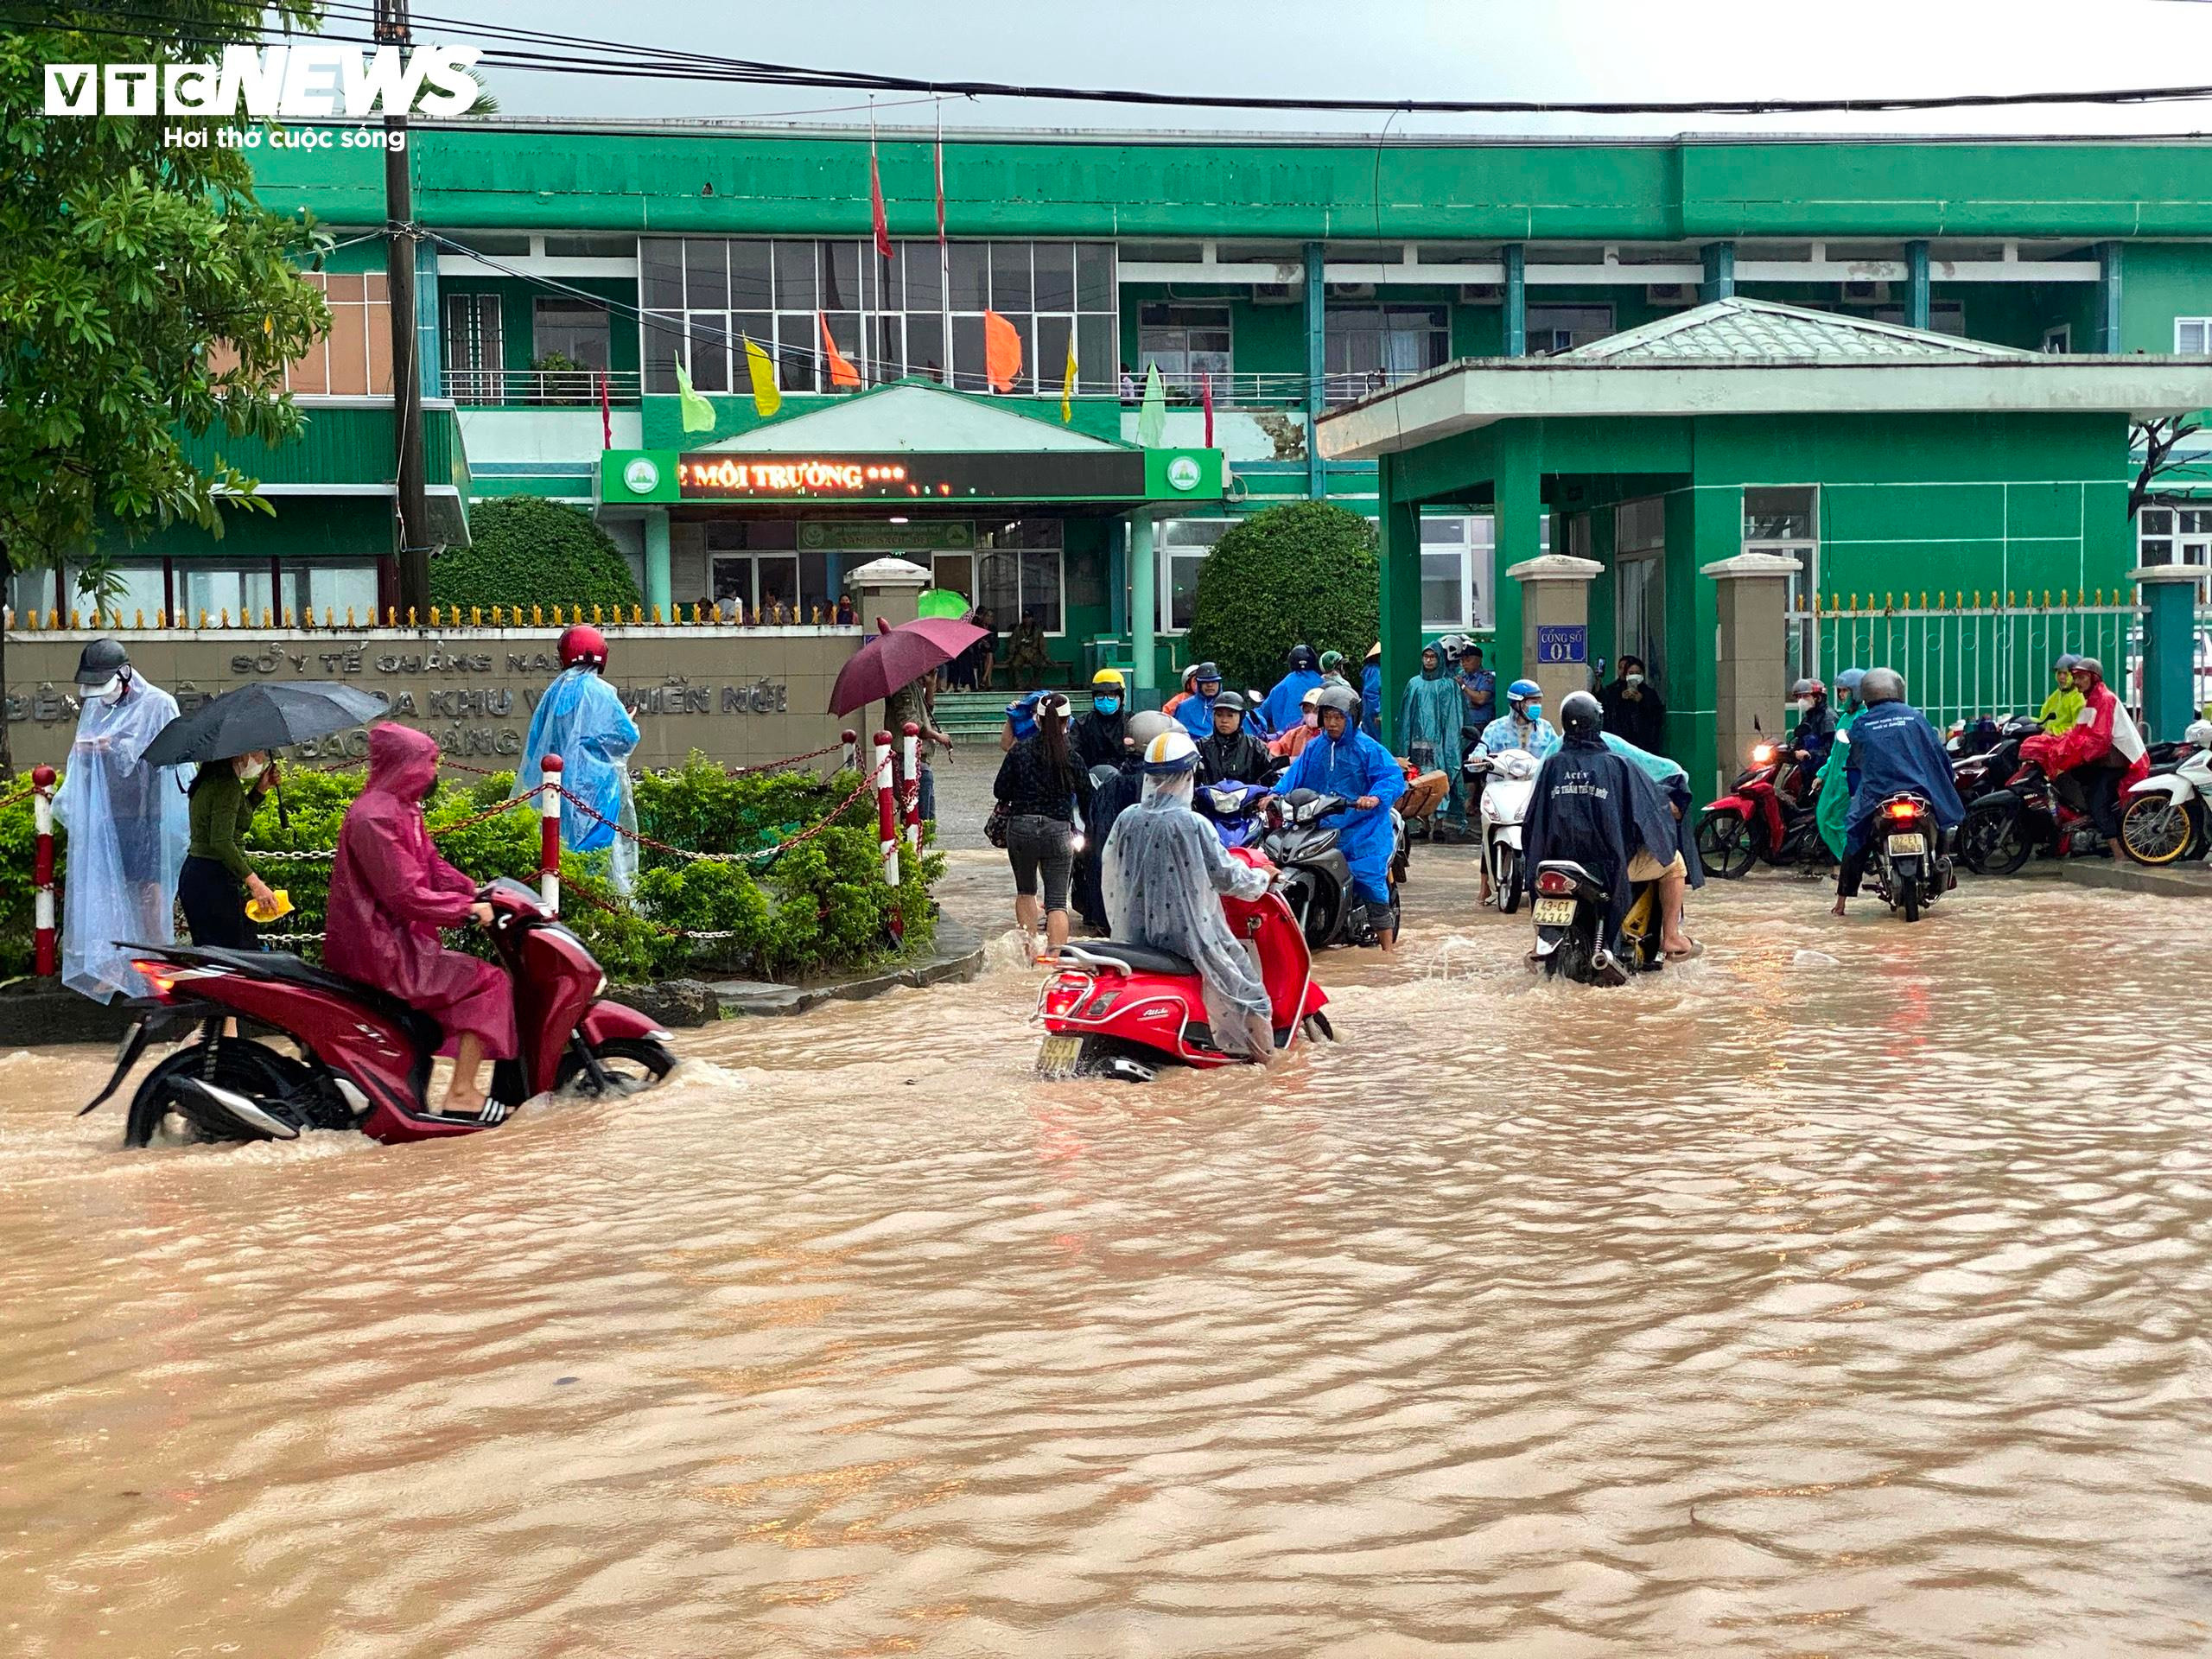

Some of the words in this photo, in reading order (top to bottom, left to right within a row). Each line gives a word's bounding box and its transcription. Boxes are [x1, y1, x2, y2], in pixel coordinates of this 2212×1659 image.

[1541, 629, 1567, 643] CỔNG
[1569, 628, 1583, 643] SỐ
[289, 654, 310, 675] Y
[319, 641, 369, 673] TẾ
[1550, 643, 1573, 660] 01
[430, 688, 513, 716] KHU
[1541, 900, 1570, 912] 43-C1
